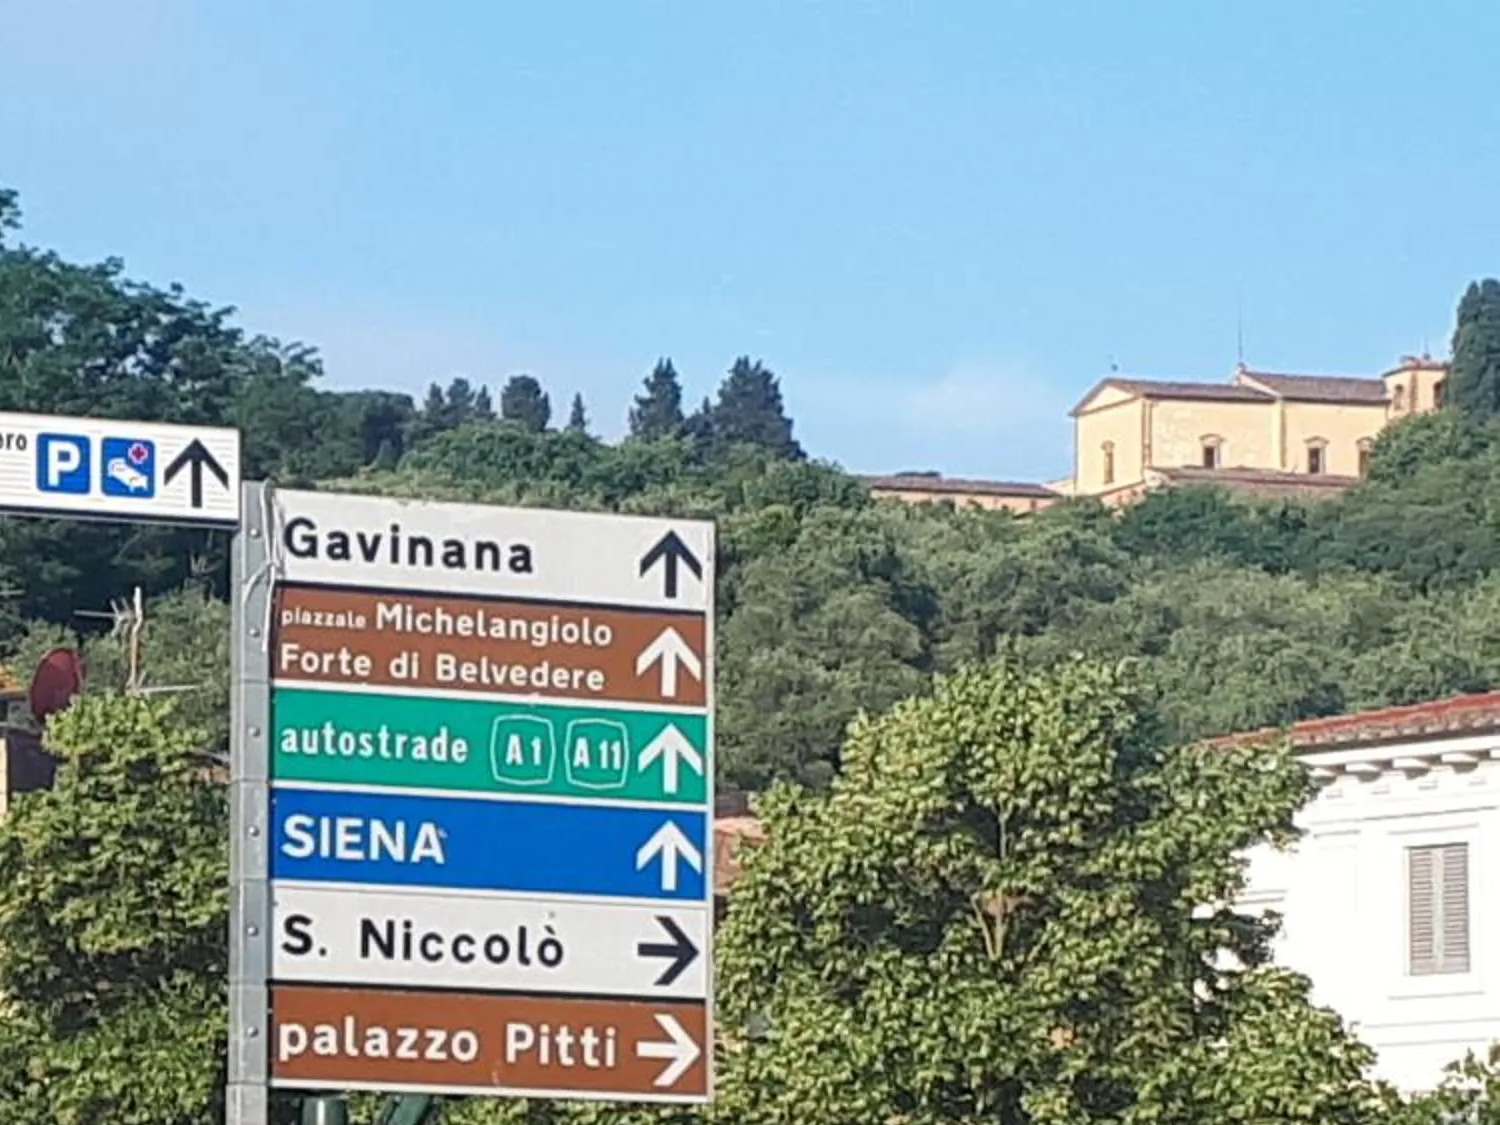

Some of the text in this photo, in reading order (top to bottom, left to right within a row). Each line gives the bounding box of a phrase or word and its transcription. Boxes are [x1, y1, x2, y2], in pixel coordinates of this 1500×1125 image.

[284, 517, 534, 574] Gavinana
[281, 602, 612, 647] piazzale Michelangiolo
[281, 644, 605, 691] Forte di Belvedere
[281, 724, 468, 763] autostrade
[281, 814, 445, 864] SIENA
[282, 915, 564, 968] S. Niccolò
[279, 1015, 616, 1067] palazzo Pitti
